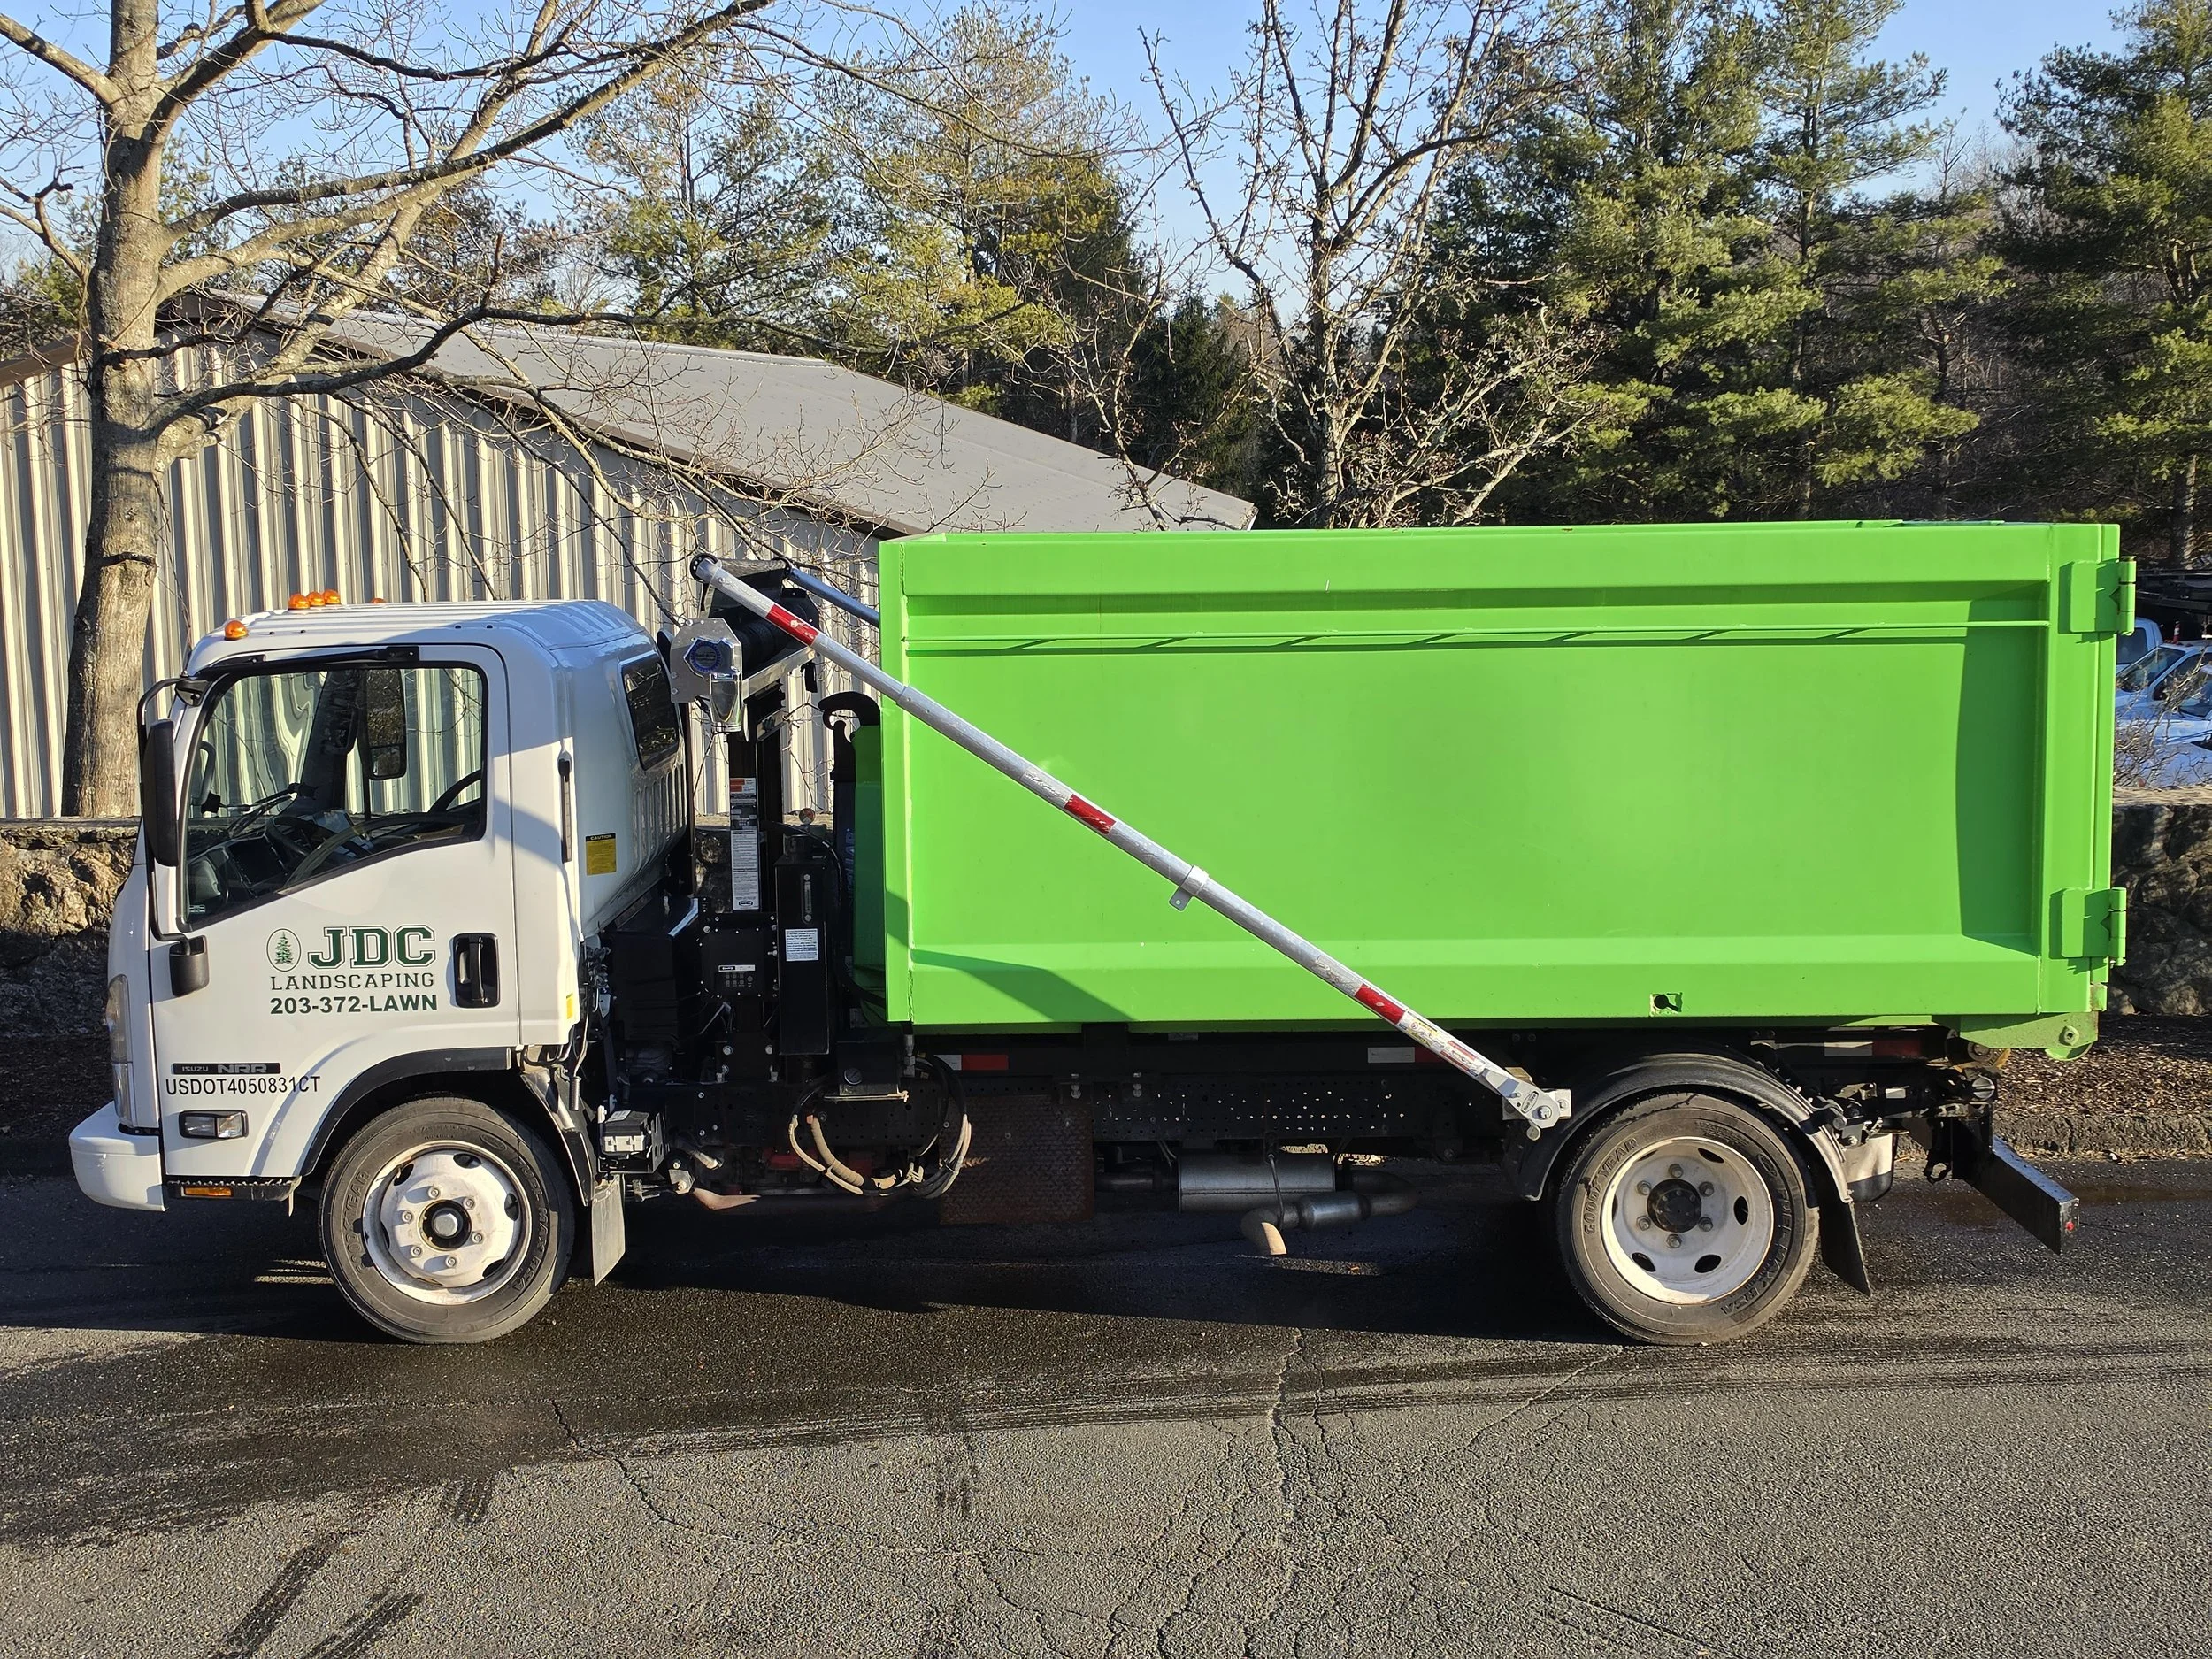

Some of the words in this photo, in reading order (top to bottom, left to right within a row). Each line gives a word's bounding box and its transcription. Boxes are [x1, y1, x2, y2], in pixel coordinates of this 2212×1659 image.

[307, 925, 436, 969] JDC
[271, 972, 434, 990] LANDSCAPING
[270, 995, 437, 1014] 203-372-LAWN
[217, 1064, 267, 1074] NRR
[165, 1076, 320, 1095] USDOT4050831CT
[1584, 1137, 1637, 1235] GOODYEAR
[342, 1170, 371, 1275] GOODYEAR
